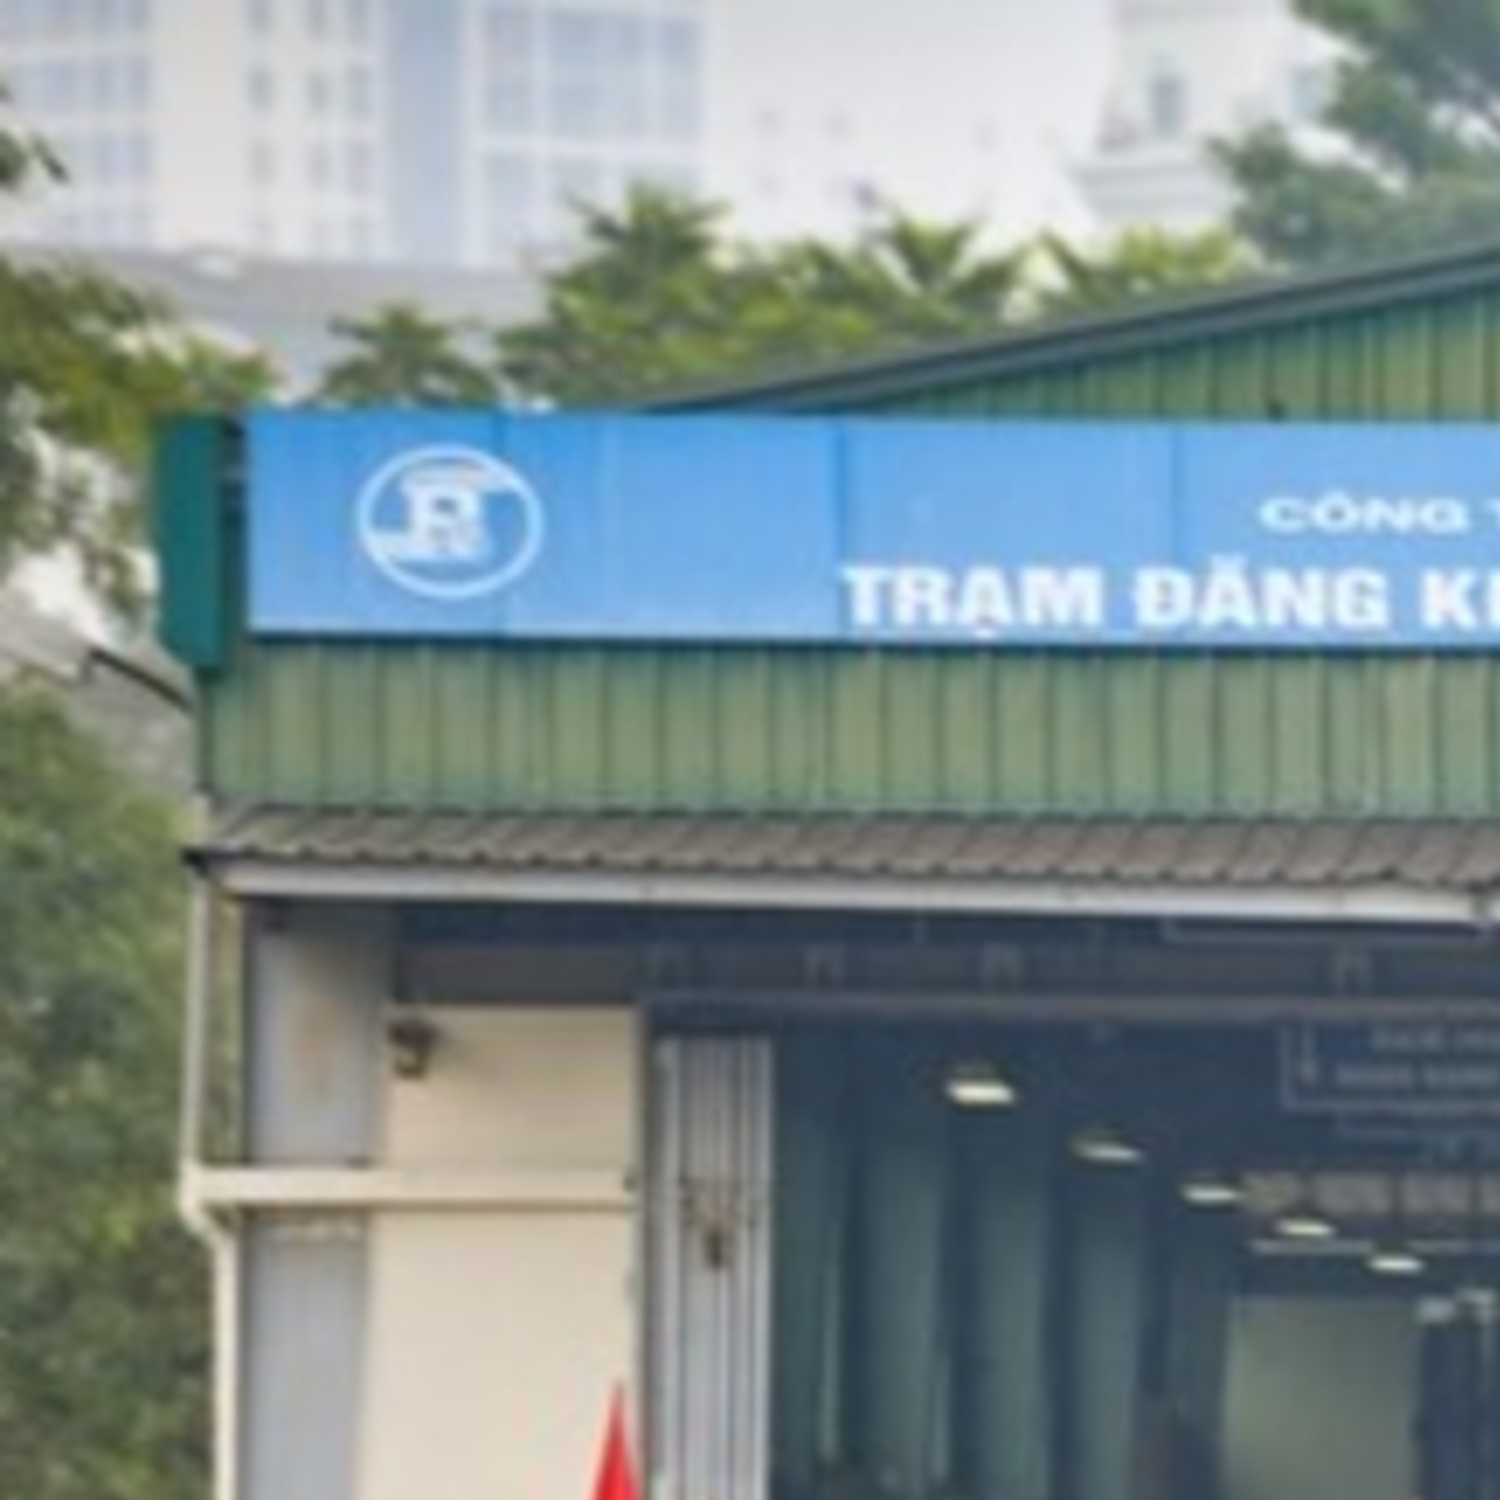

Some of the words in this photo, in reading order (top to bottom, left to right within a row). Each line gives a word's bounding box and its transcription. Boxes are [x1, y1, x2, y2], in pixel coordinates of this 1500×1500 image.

[1257, 491, 1470, 535] CÔNG
[840, 564, 1102, 639] TRẠM
[1130, 555, 1392, 632] ĐĂNG
